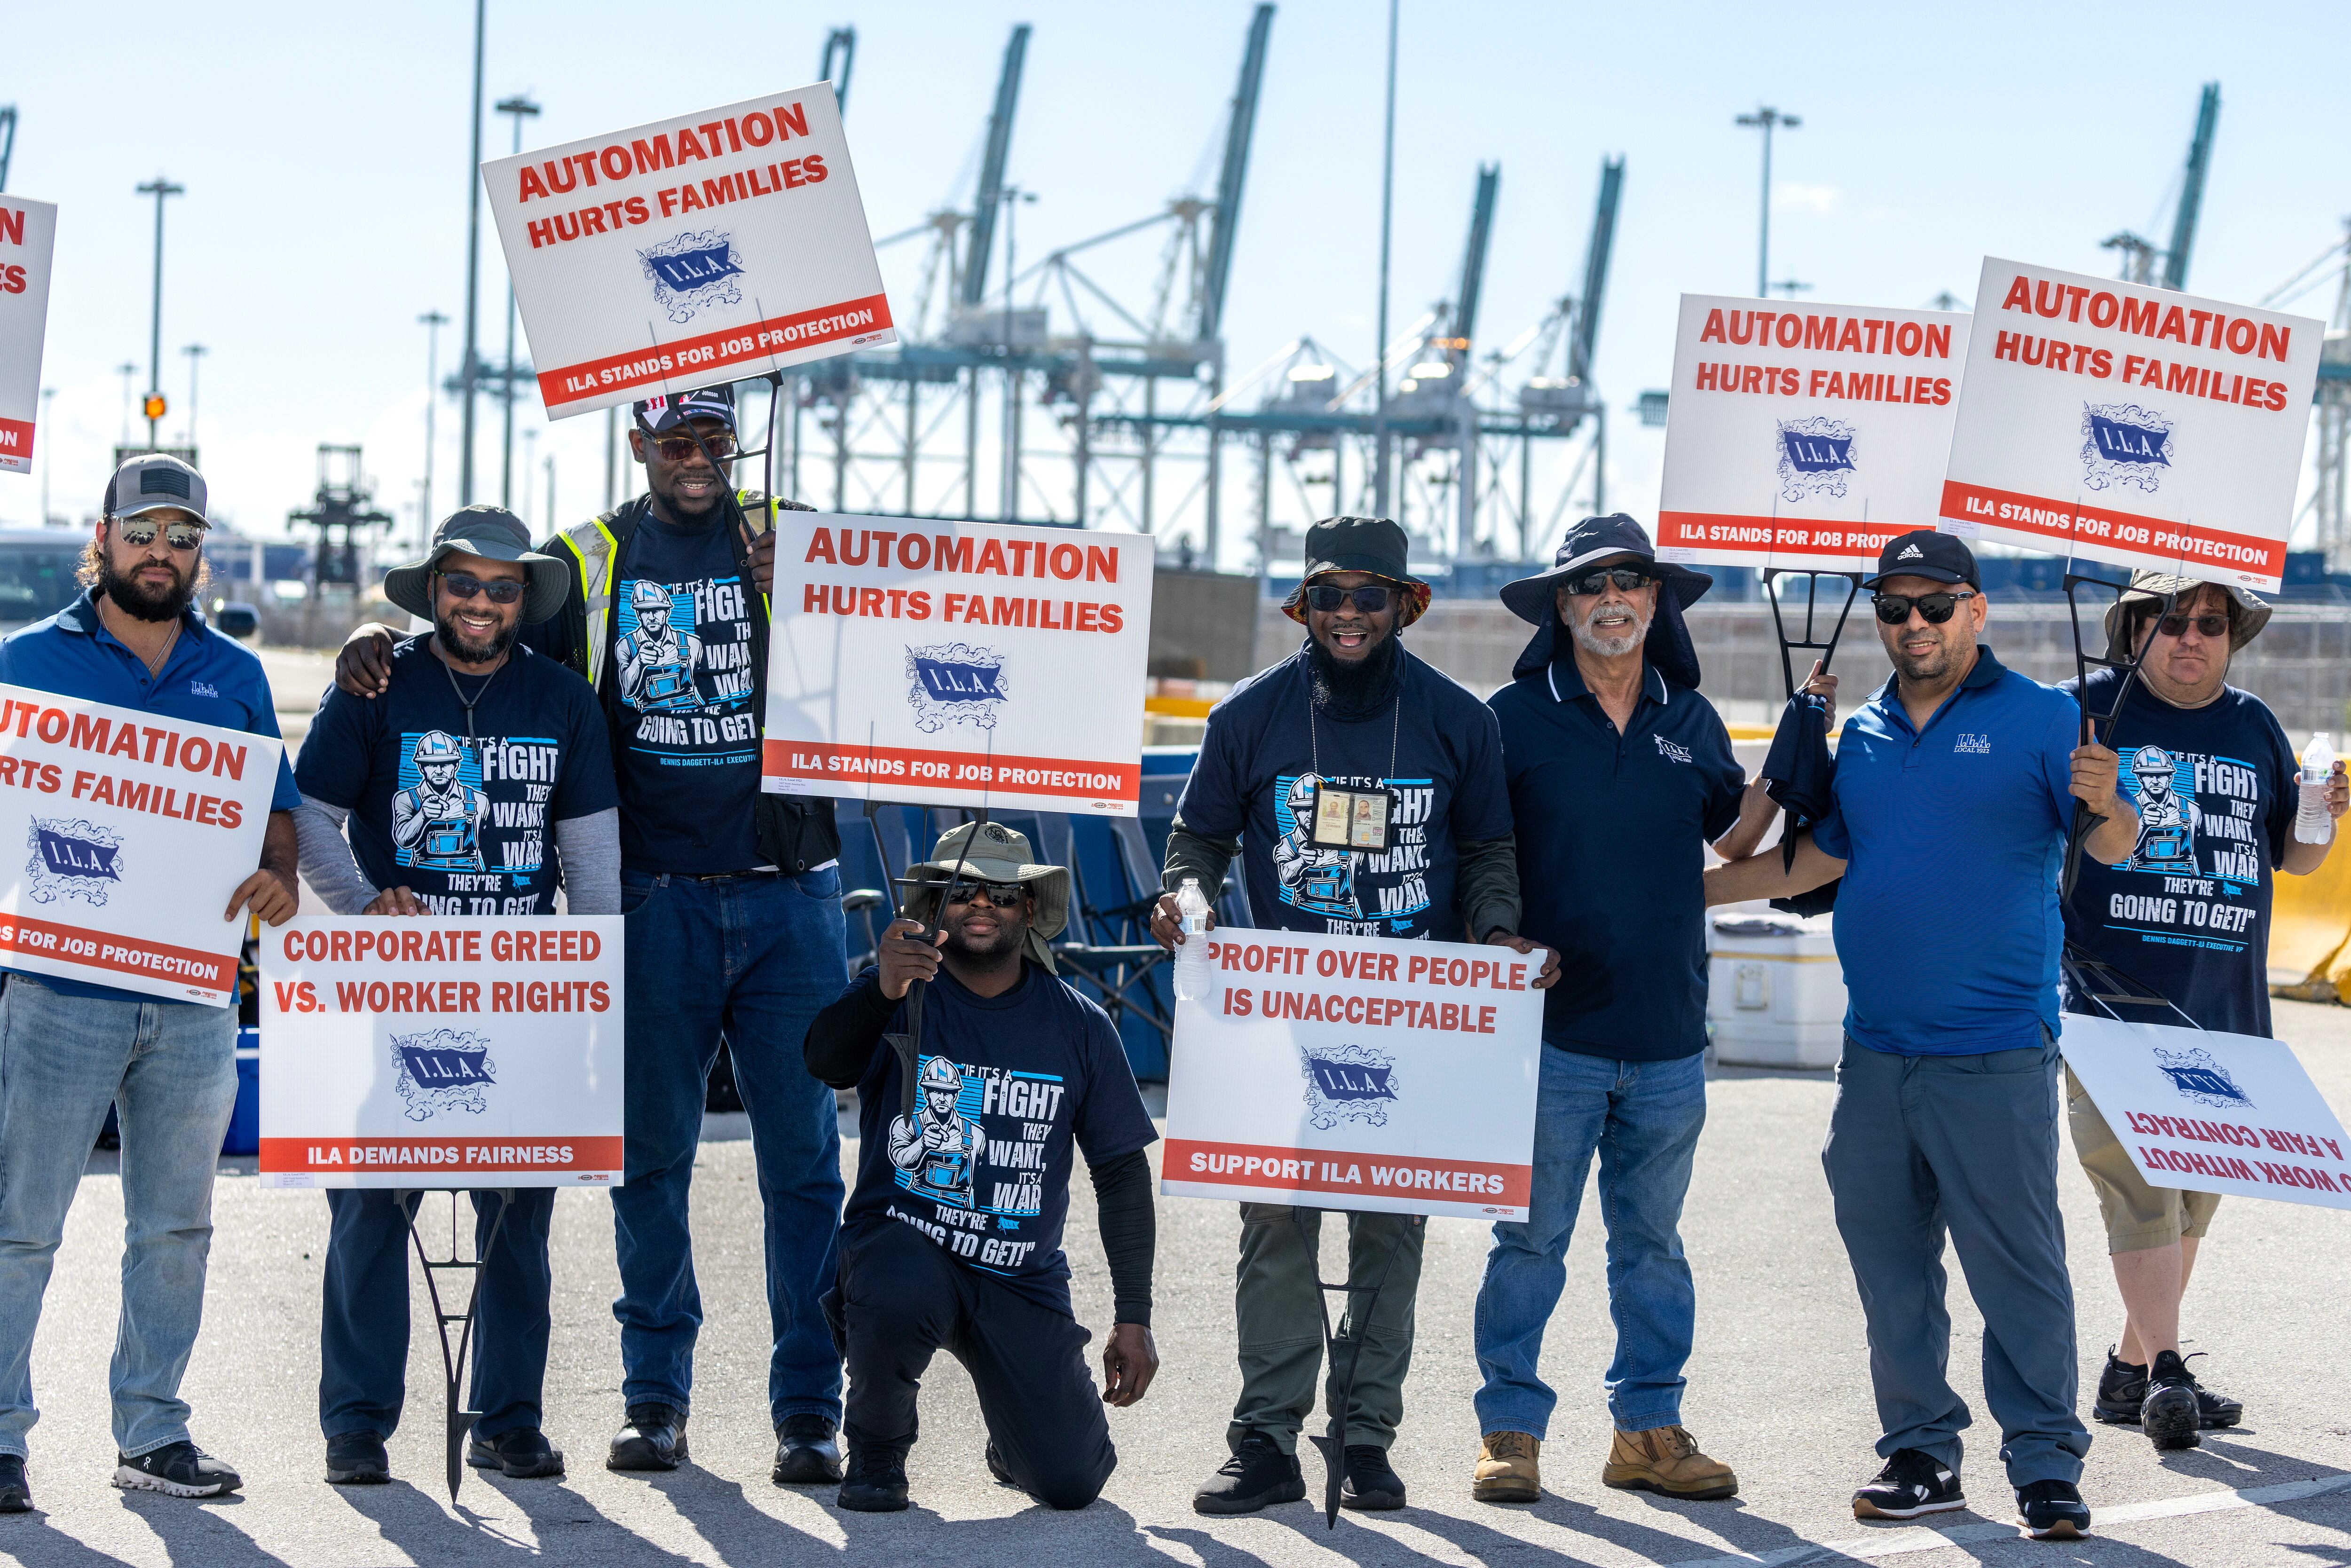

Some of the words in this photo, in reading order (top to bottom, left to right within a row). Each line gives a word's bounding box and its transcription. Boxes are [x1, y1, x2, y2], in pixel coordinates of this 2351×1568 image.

[520, 103, 808, 203] AUTOMATION
[528, 197, 649, 248] HURTS
[657, 155, 828, 218] FAMILIES
[665, 256, 730, 281] I.L.A.
[1701, 309, 1951, 358] AUTOMATION
[2003, 276, 2290, 362] AUTOMATION
[567, 373, 598, 392] ILA
[601, 355, 673, 384] STANDS
[677, 346, 715, 367] FOR
[720, 337, 754, 357] JOB
[758, 308, 873, 347] PROTECTION
[1697, 363, 1799, 395] HURTS
[1809, 370, 1951, 405] FAMILIES
[1995, 331, 2113, 378] HURTS
[2122, 355, 2287, 411] FAMILIES
[1795, 442, 1846, 463] I.L.A.
[2103, 427, 2160, 457] I.L.A.
[1680, 524, 1706, 539] ILA
[1710, 526, 1772, 543] STANDS
[1776, 529, 1808, 544] FOR
[1812, 531, 1842, 546] JOB
[1966, 496, 1994, 516] ILA
[1999, 504, 2070, 529] STANDS
[2075, 517, 2111, 537] FOR
[2114, 525, 2149, 544] JOB
[2154, 529, 2268, 565] PROTECTION
[805, 528, 1118, 583] AUTOMATION
[1897, 552, 1924, 560] adidas
[686, 578, 703, 593] IT'S
[707, 578, 716, 588] A
[694, 585, 748, 625] FIGH
[804, 584, 931, 620] HURTS
[944, 593, 1123, 633] FAMILIES
[734, 622, 751, 641] TH
[713, 668, 753, 700] WA
[929, 669, 994, 693] I.L.A.
[499, 737, 509, 748] A
[637, 716, 689, 745] GOING
[691, 718, 718, 745] TO
[1955, 734, 1991, 748] I.L.A.
[483, 746, 558, 782] FIGHT
[660, 757, 681, 766] DENNIS
[682, 757, 724, 766] DAGGETT-ILA
[727, 754, 757, 764] EXECUTIV
[792, 753, 822, 770] ILA
[828, 756, 905, 775] STANDS
[911, 761, 950, 778] FOR
[955, 764, 992, 781] JOB
[999, 767, 1121, 790] PROTECTION
[2187, 753, 2206, 764] IT'S
[2209, 756, 2217, 765] A
[526, 784, 552, 802] THEY
[1351, 776, 1372, 788] IT'S
[1375, 778, 1384, 789] A
[2194, 763, 2257, 801] FIGHT
[72, 771, 242, 828] FAMILIES
[1372, 799, 1384, 821] TWIC
[1391, 788, 1434, 824] GHT
[2231, 800, 2256, 819] THEY
[523, 830, 537, 842] IT'S
[537, 829, 542, 841] A
[2204, 814, 2257, 846] WANT,
[50, 842, 109, 872] I.L.A.
[502, 841, 543, 870] WAR
[2234, 843, 2250, 856] IT'S
[2251, 846, 2257, 857] A
[448, 874, 502, 891] THEY'RE
[2213, 851, 2258, 884] WAR
[1378, 878, 1429, 915] WAR
[2164, 876, 2215, 897] THEY'RE
[469, 898, 496, 915] TO
[2110, 893, 2177, 924] GOING
[2183, 900, 2208, 927] TO
[1326, 919, 1380, 937] THEY'RE
[18, 929, 57, 949] FOR
[61, 937, 96, 956] JOB
[101, 945, 218, 980] PROTECTION
[284, 931, 481, 961] CORPORATE
[491, 931, 600, 961] GREED
[2142, 935, 2166, 944] DENNIS
[2168, 937, 2204, 947] DAGGETT-ILA
[2206, 941, 2234, 952] EXECUTIVE
[1318, 950, 1398, 980] OVER
[1409, 957, 1525, 990] PEOPLE
[274, 982, 325, 1013] VS.
[337, 982, 480, 1012] WORKER
[493, 982, 609, 1012] RIGHTS
[1225, 989, 1251, 1016] IS
[1263, 991, 1495, 1032] UNACCEPTABLE
[415, 1057, 482, 1077] I.L.A.
[978, 1066, 1000, 1080] IT'S
[1003, 1070, 1012, 1081] A
[1324, 1070, 1385, 1092] I.L.A.
[983, 1079, 1064, 1121] FIGHT
[1023, 1122, 1053, 1141] THEY
[2125, 1111, 2260, 1148] CONTRACT
[2258, 1128, 2325, 1157] FAIR
[308, 1147, 343, 1164] ILA
[349, 1147, 459, 1164] DEMANDS
[466, 1146, 573, 1163] FAIRNESS
[989, 1140, 1046, 1172] WANT,
[2319, 1137, 2344, 1160] A
[1019, 1172, 1035, 1184] IT'S
[1035, 1173, 1042, 1184] A
[1190, 1152, 1314, 1180] SUPPORT
[1321, 1162, 1362, 1183] ILA
[1370, 1166, 1504, 1194] WORKERS
[2138, 1146, 2260, 1182] WITHOUT
[2253, 1161, 2343, 1193] WORK
[992, 1182, 1041, 1214] WAR
[936, 1204, 989, 1230] THEY'RE
[951, 1230, 979, 1258] TO
